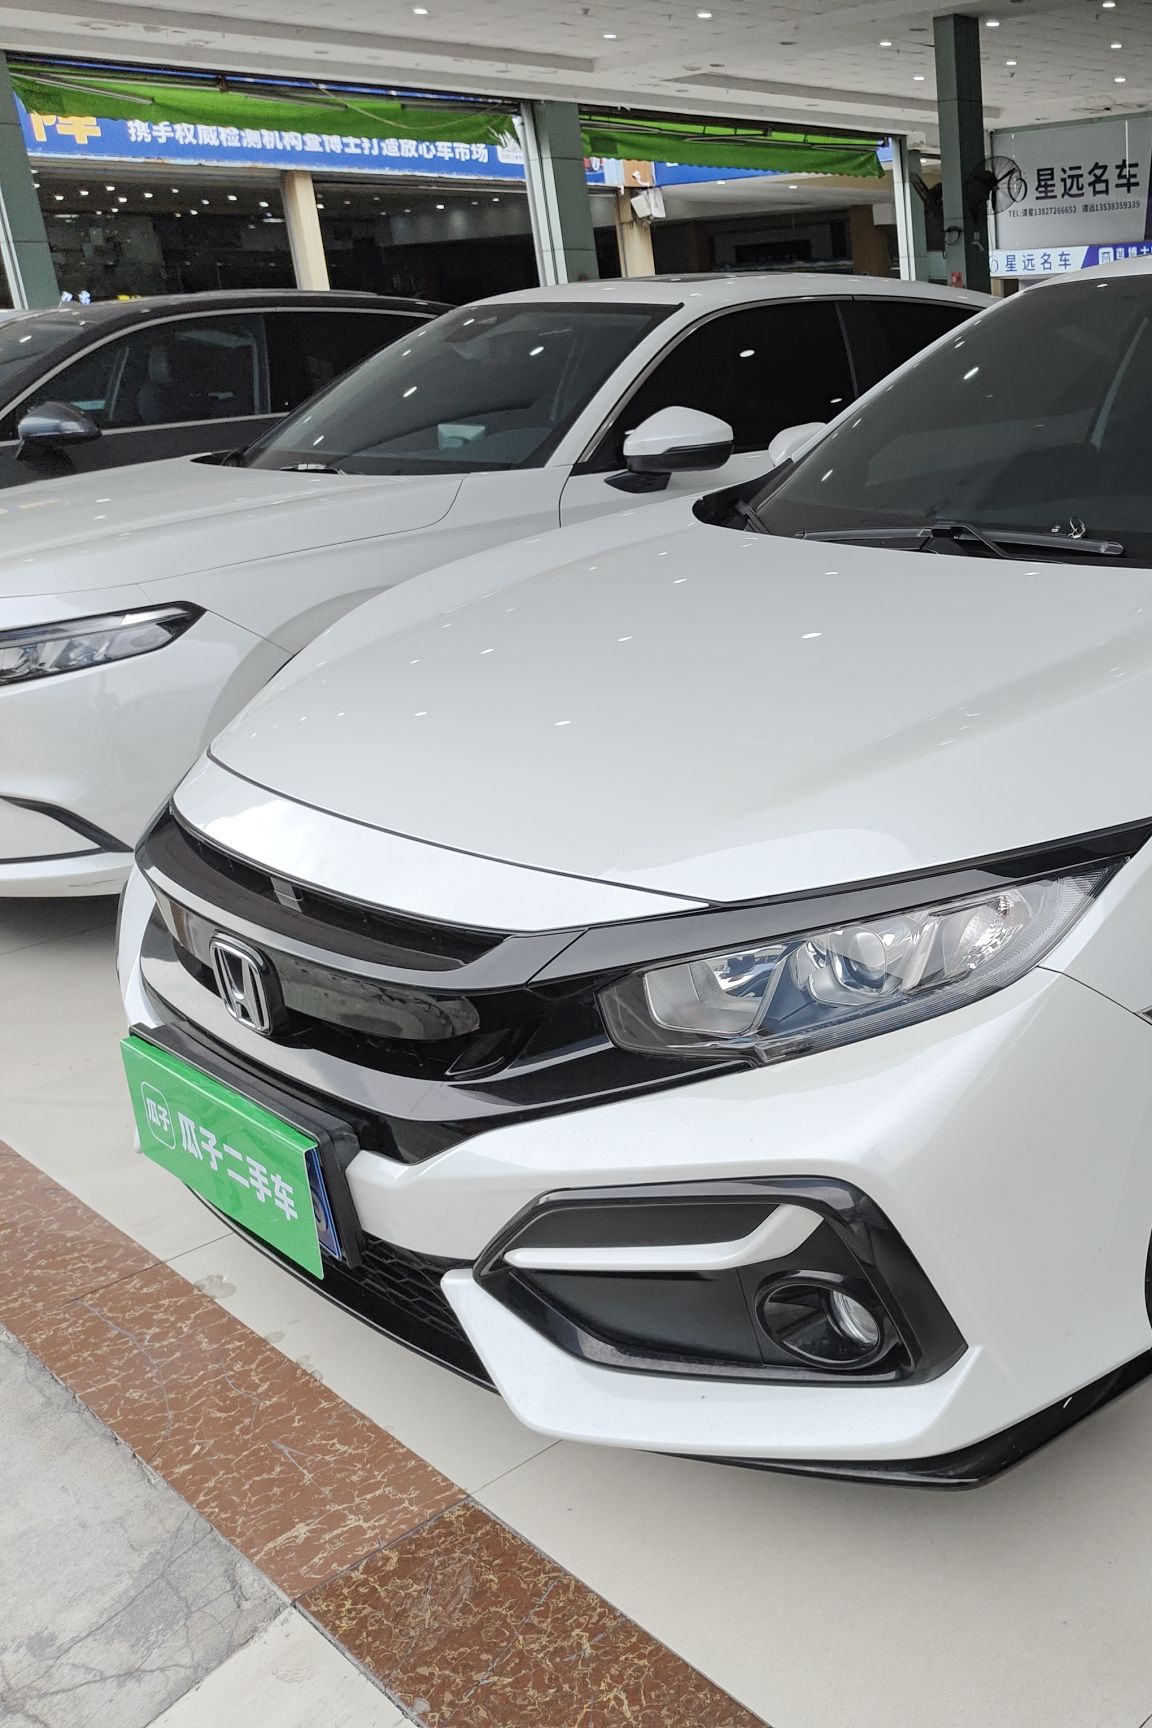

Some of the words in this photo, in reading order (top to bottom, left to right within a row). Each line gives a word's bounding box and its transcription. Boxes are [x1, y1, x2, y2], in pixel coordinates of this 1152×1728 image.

[1035, 159, 1140, 200] 星远名车
[1005, 251, 1072, 273] 星远名车
[146, 1097, 170, 1131] 瓜子
[178, 1111, 298, 1221] 瓜子二手车
